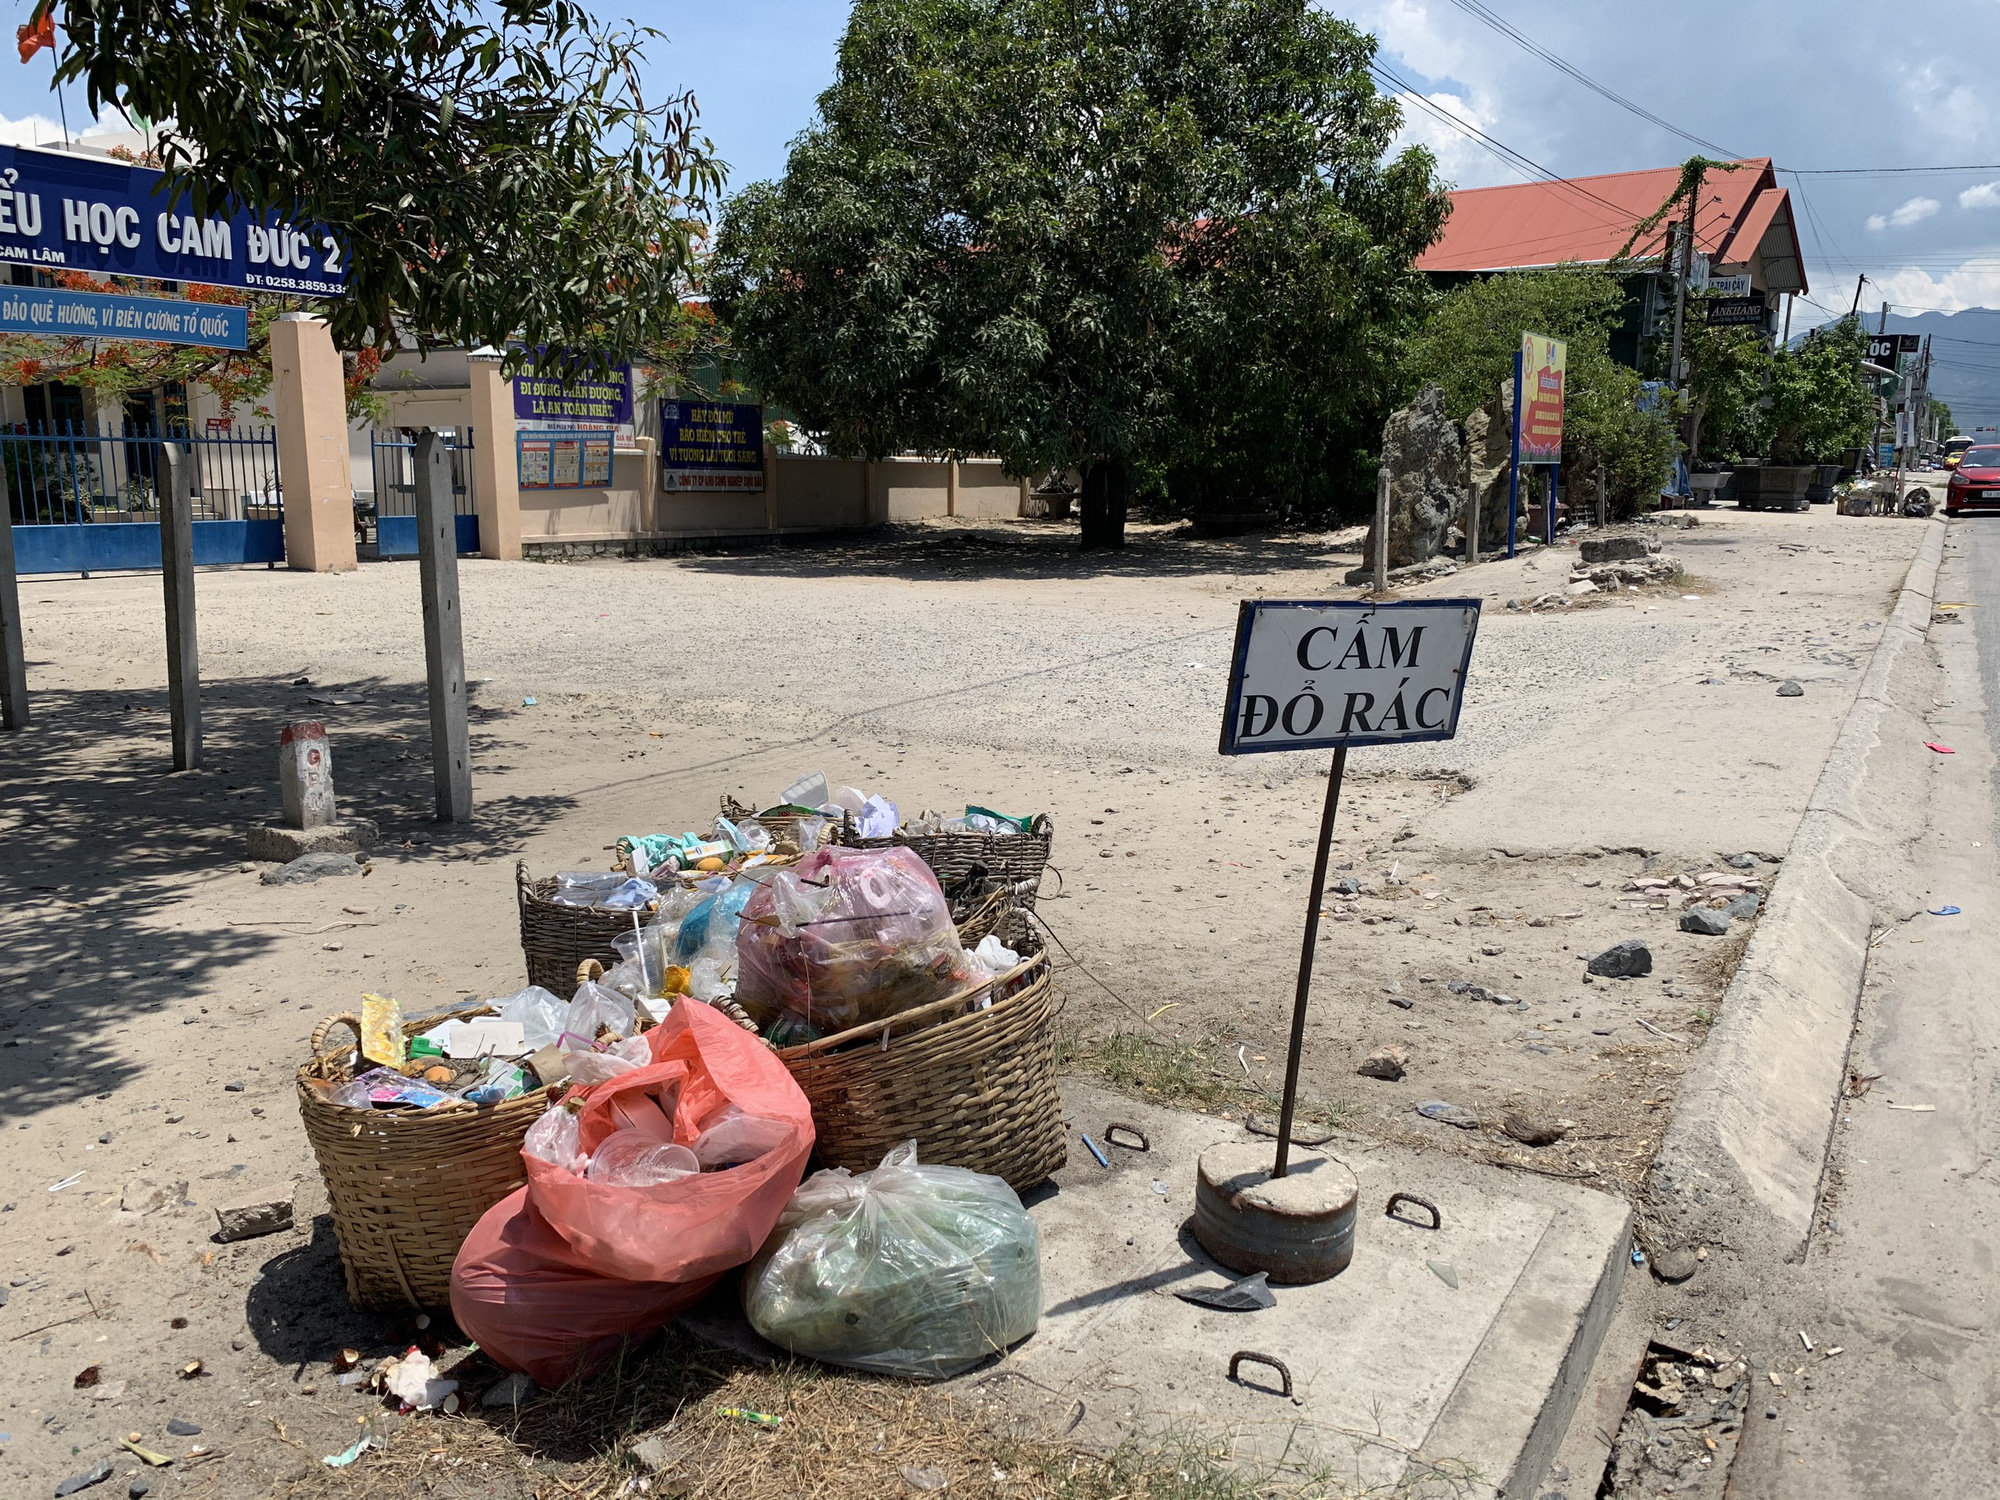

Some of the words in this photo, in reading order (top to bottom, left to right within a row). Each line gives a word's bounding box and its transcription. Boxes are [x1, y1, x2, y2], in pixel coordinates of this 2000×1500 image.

[63, 198, 141, 254] HỌC
[157, 212, 233, 260] CAM
[247, 218, 311, 270] ĐỨC
[322, 236, 343, 273] 2
[32, 247, 66, 263] LÂM
[246, 273, 264, 285] ĐT:
[2, 294, 28, 322] ĐẢO
[31, 299, 54, 326] QUÊ
[58, 302, 98, 329] HƯƠNG,
[102, 304, 114, 327] VÌ
[115, 306, 143, 329] BIÊN
[145, 309, 181, 333] CƯƠNG
[183, 307, 200, 334] TỔ
[200, 312, 229, 338] QUỐC
[520, 381, 532, 395] ĐI
[533, 380, 561, 397] ĐÚNG
[532, 398, 547, 414] LÀ
[547, 401, 561, 415] AN
[562, 400, 587, 416] TOÀN
[1296, 613, 1428, 671] CẤM
[1238, 679, 1325, 738] ĐỔ
[1335, 676, 1451, 734] RÁC
